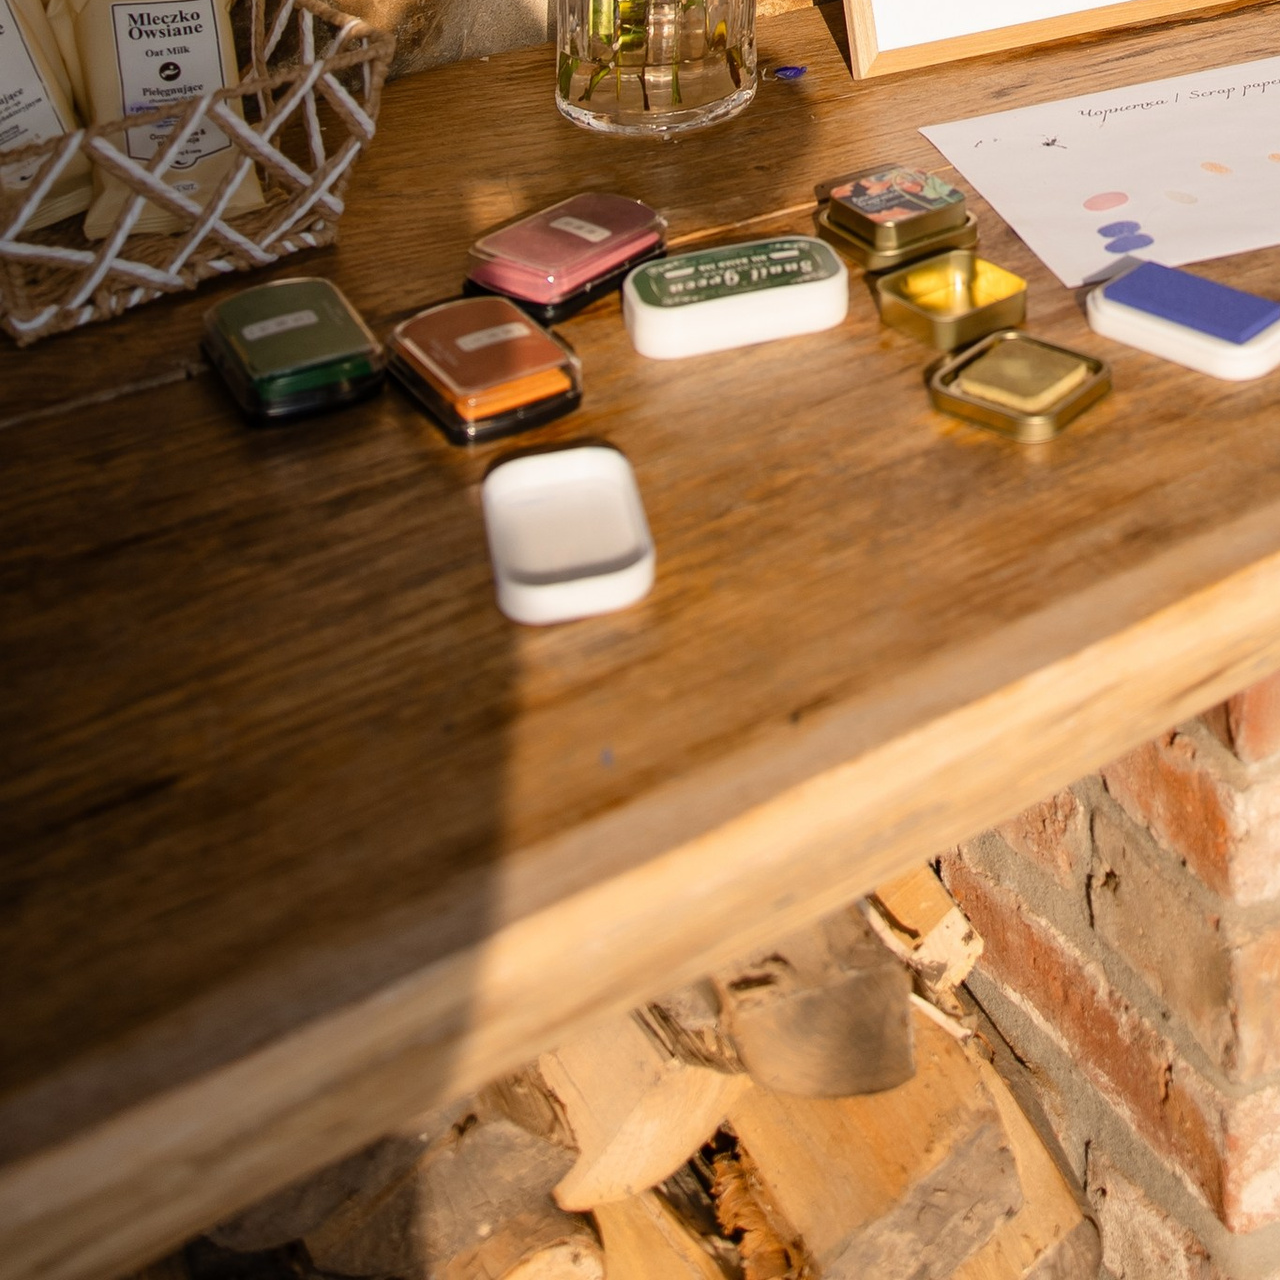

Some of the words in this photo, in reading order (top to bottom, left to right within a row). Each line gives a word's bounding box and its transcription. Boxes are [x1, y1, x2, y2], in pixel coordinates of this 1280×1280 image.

[128, 10, 200, 26] Mleczko
[128, 23, 203, 40] Owsiane
[145, 48, 163, 57] Oat
[167, 45, 190, 56] Milk
[1189, 85, 1236, 100] Scrap
